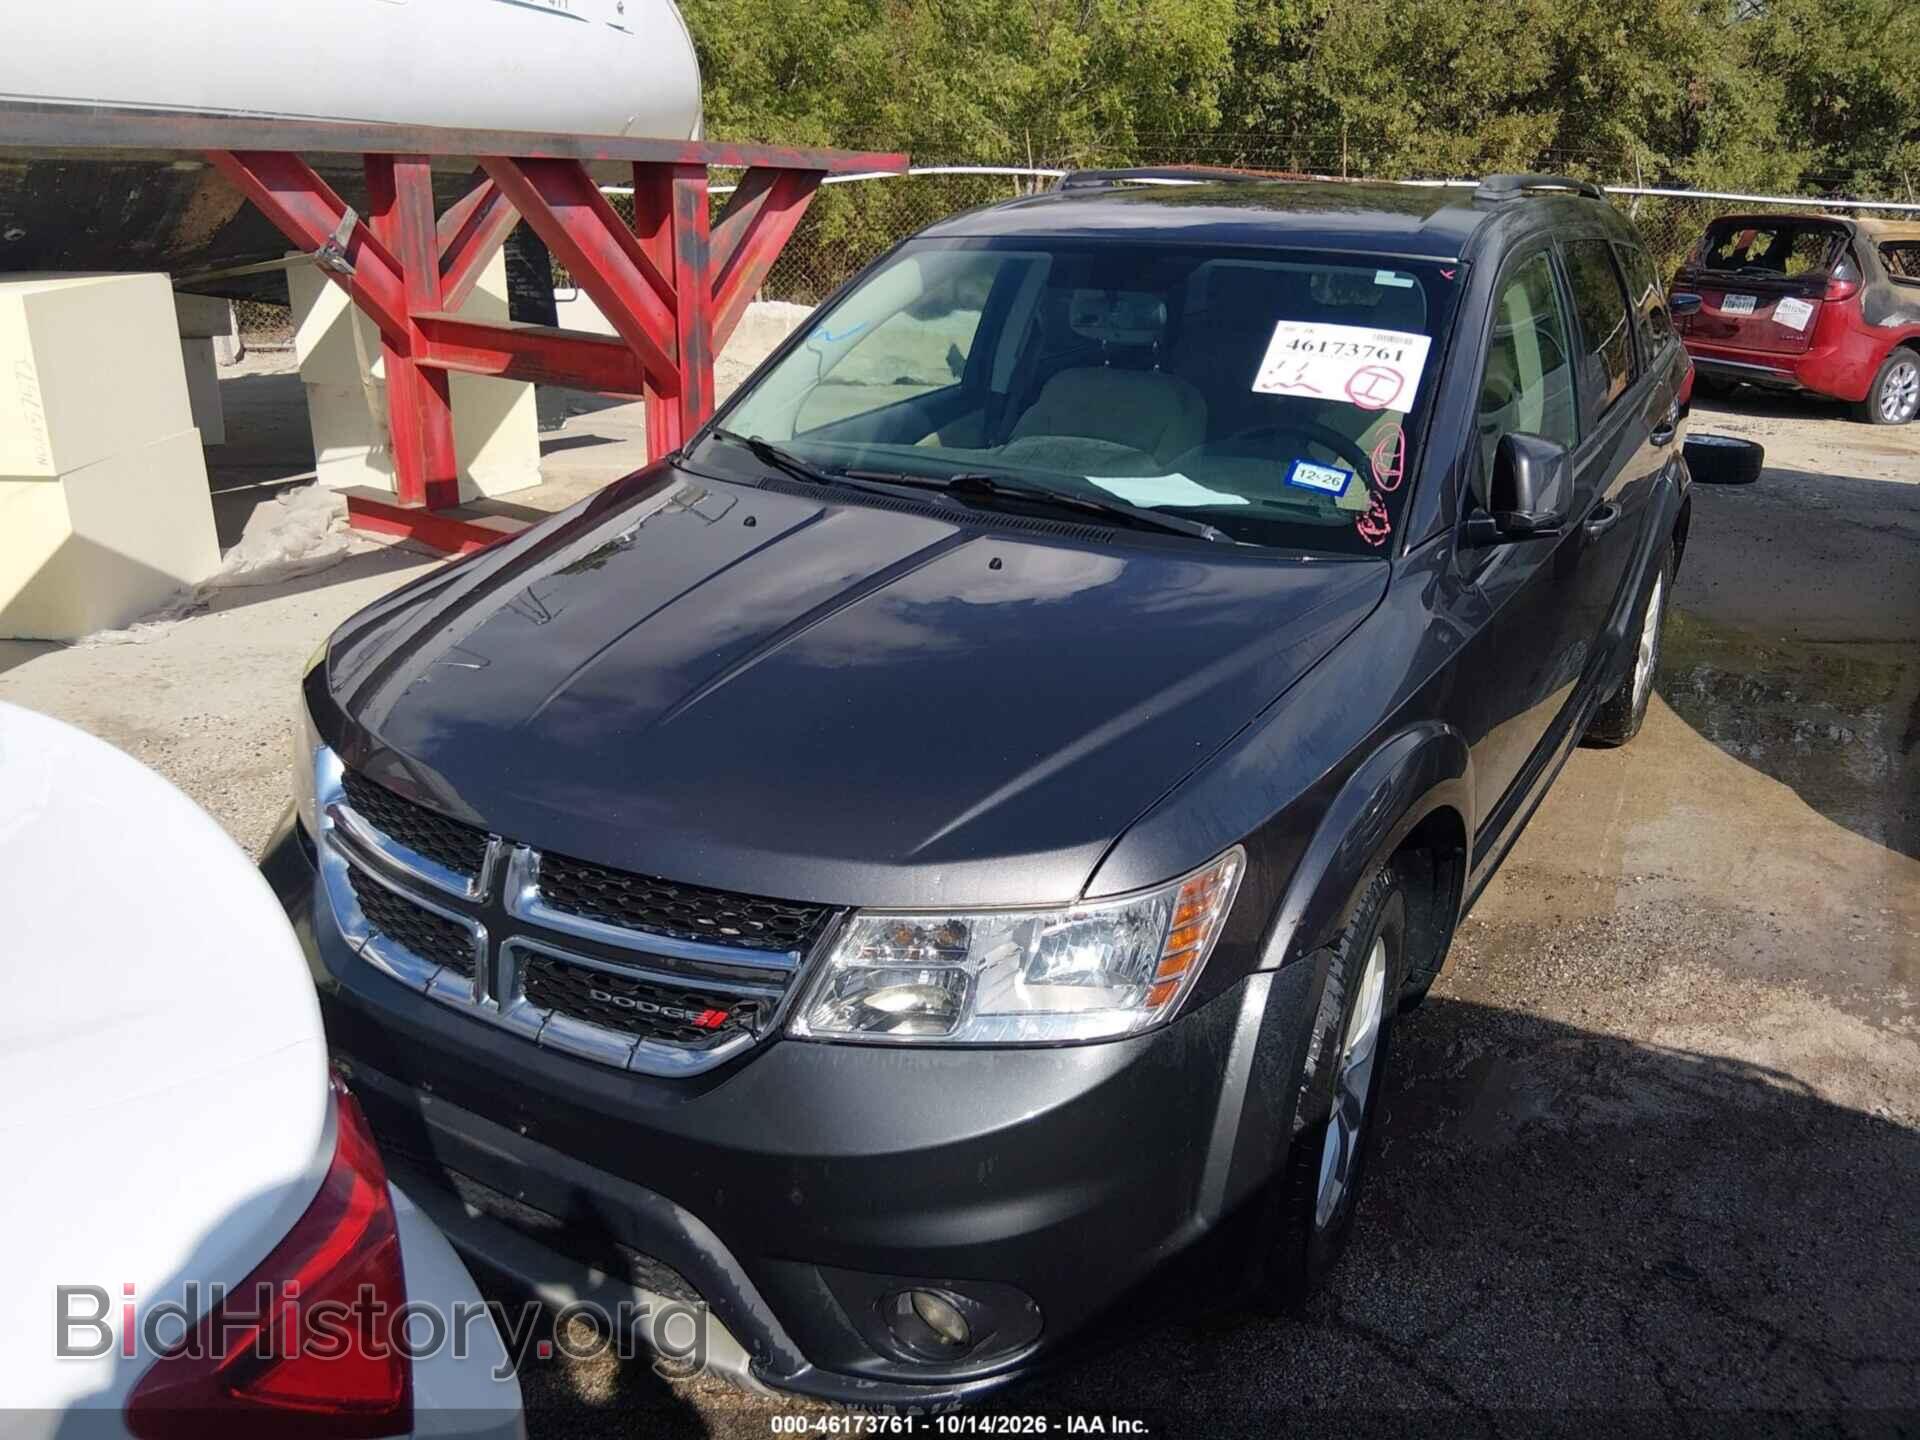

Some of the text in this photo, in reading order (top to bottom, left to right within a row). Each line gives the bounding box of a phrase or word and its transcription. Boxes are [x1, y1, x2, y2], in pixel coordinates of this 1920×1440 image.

[1286, 338, 1404, 362] 46173761
[1299, 469, 1342, 487] 12-26
[590, 989, 706, 1023] DODGE
